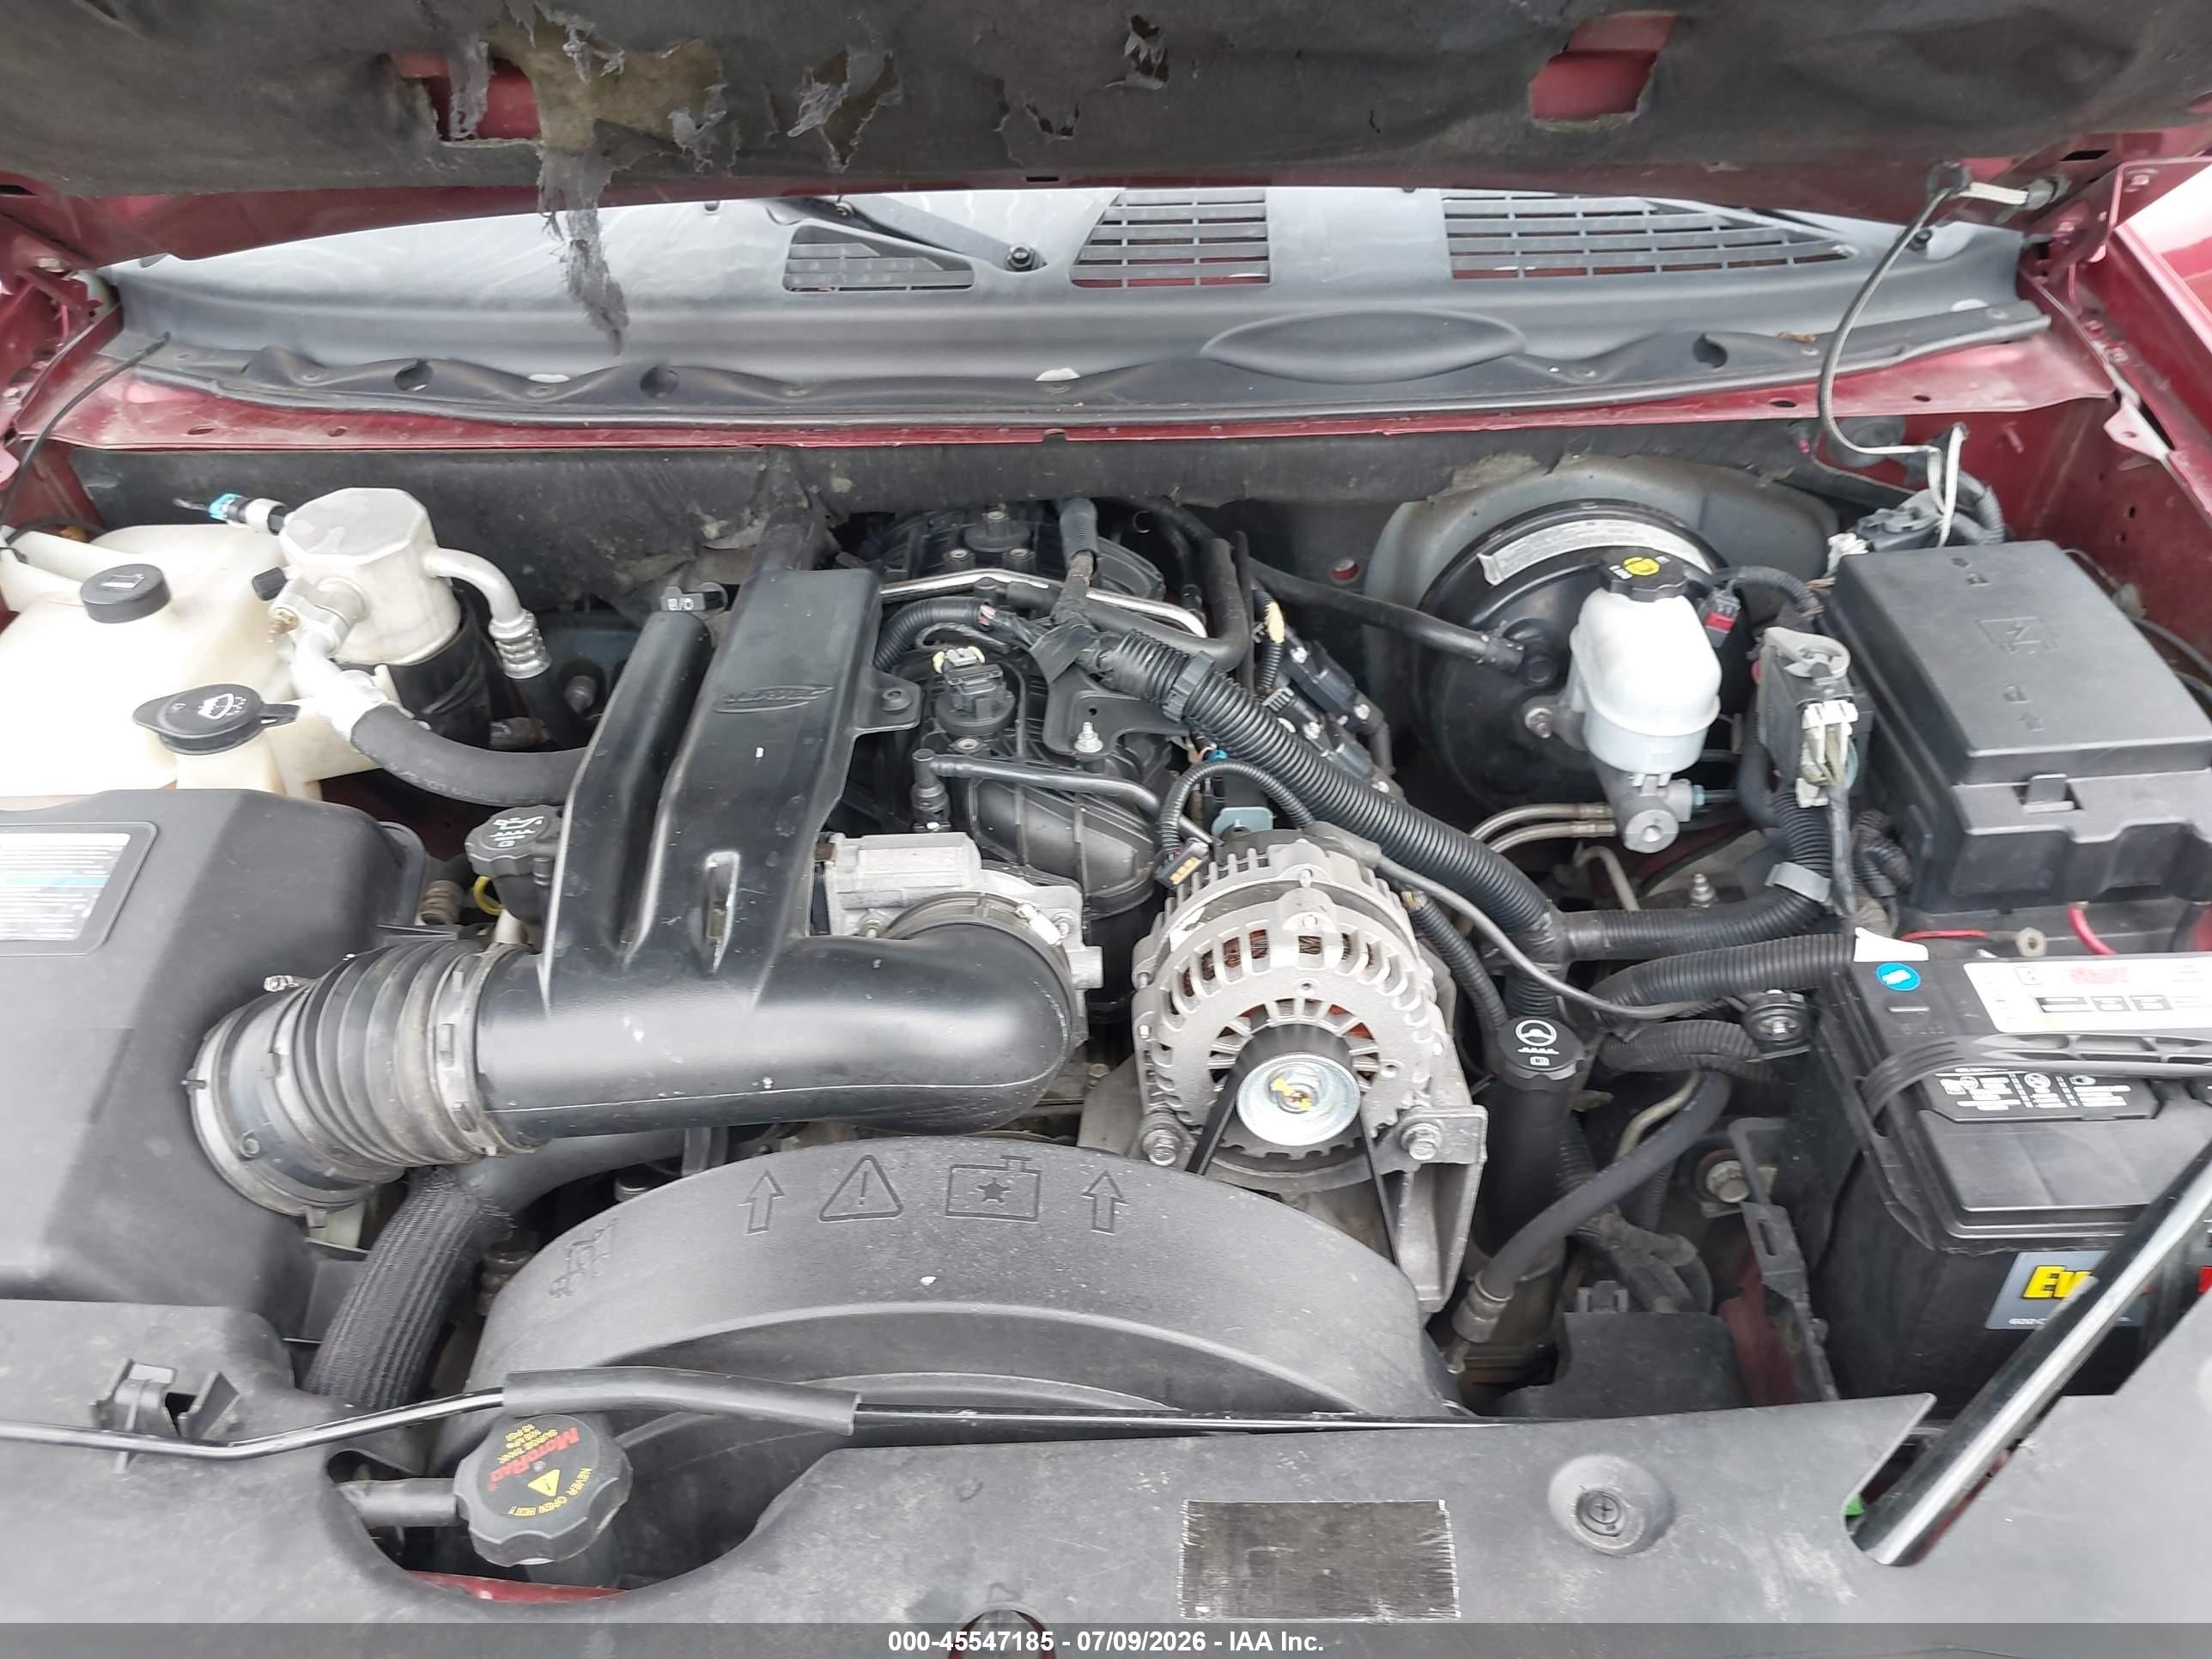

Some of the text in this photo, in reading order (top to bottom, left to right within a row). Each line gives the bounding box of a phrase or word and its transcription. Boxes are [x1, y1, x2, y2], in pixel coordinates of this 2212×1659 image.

[496, 1429, 558, 1464] SURGE TANK
[564, 1468, 593, 1496] NEVER
[538, 1495, 568, 1514] OPEN
